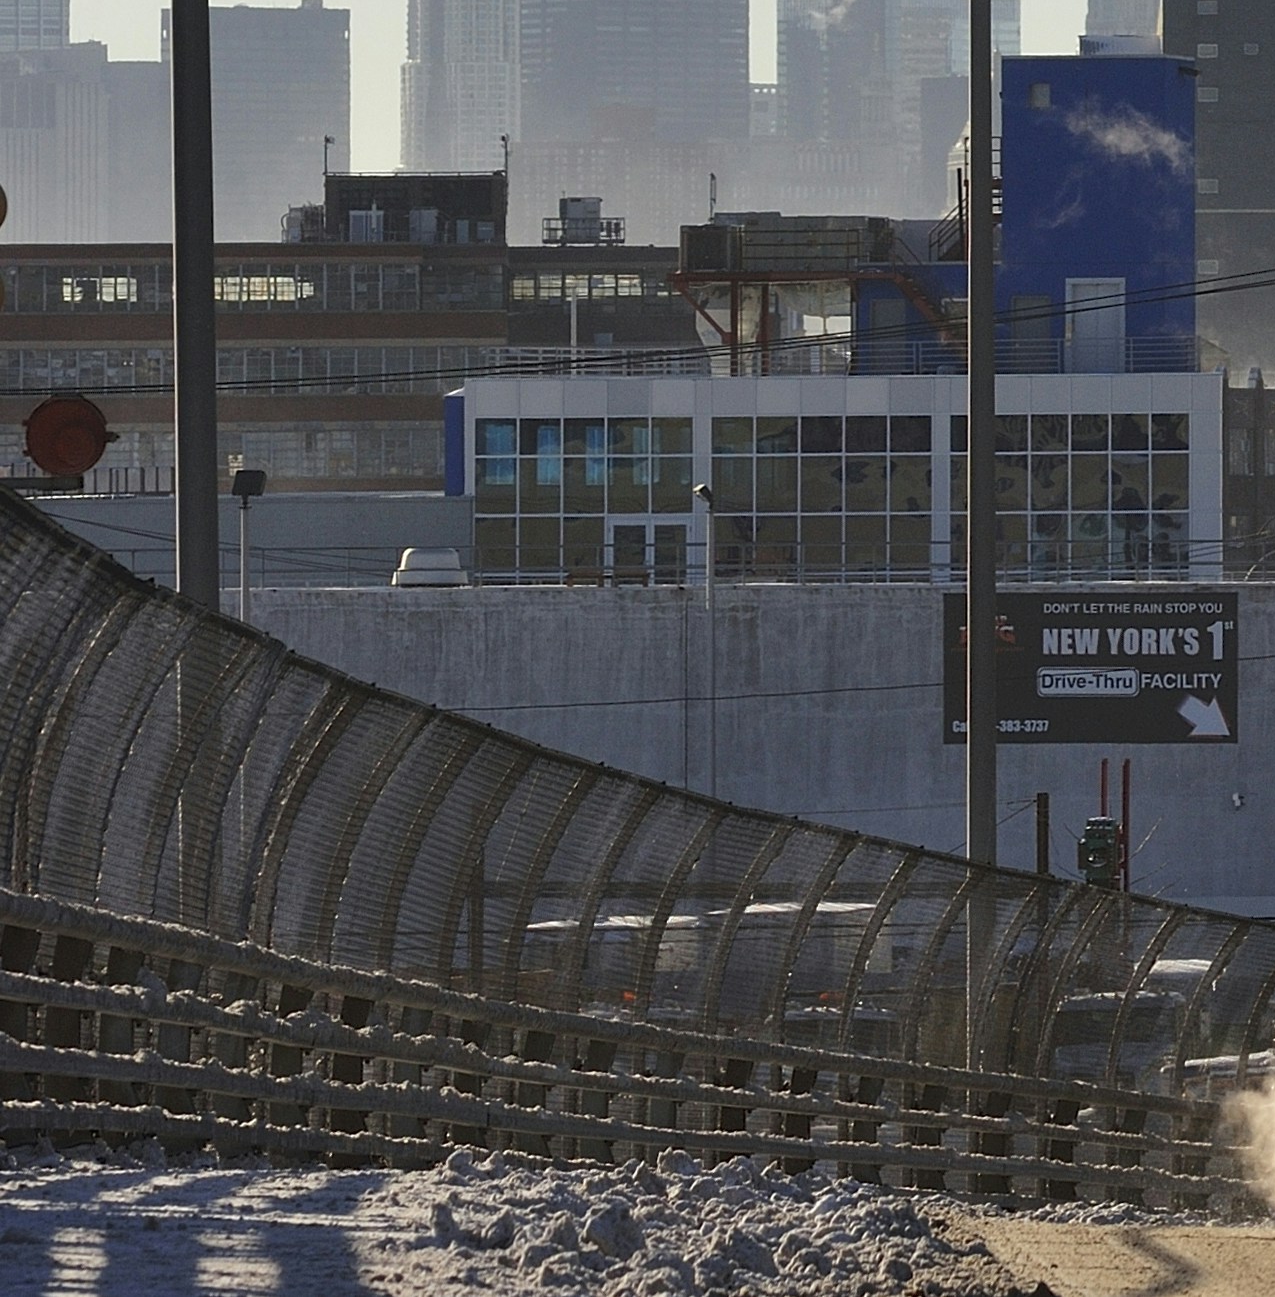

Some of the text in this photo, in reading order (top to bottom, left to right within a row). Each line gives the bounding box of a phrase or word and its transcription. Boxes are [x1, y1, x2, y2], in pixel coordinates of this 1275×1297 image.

[1043, 603, 1223, 614] DON'T LET THE RAIN STOP YOU
[1042, 628, 1099, 655] NEW
[1106, 627, 1200, 656] YORK'S
[1206, 620, 1234, 660] 1st
[1041, 673, 1222, 689] Drive-Thru FACILITY
[995, 719, 1050, 733] -383-3737
